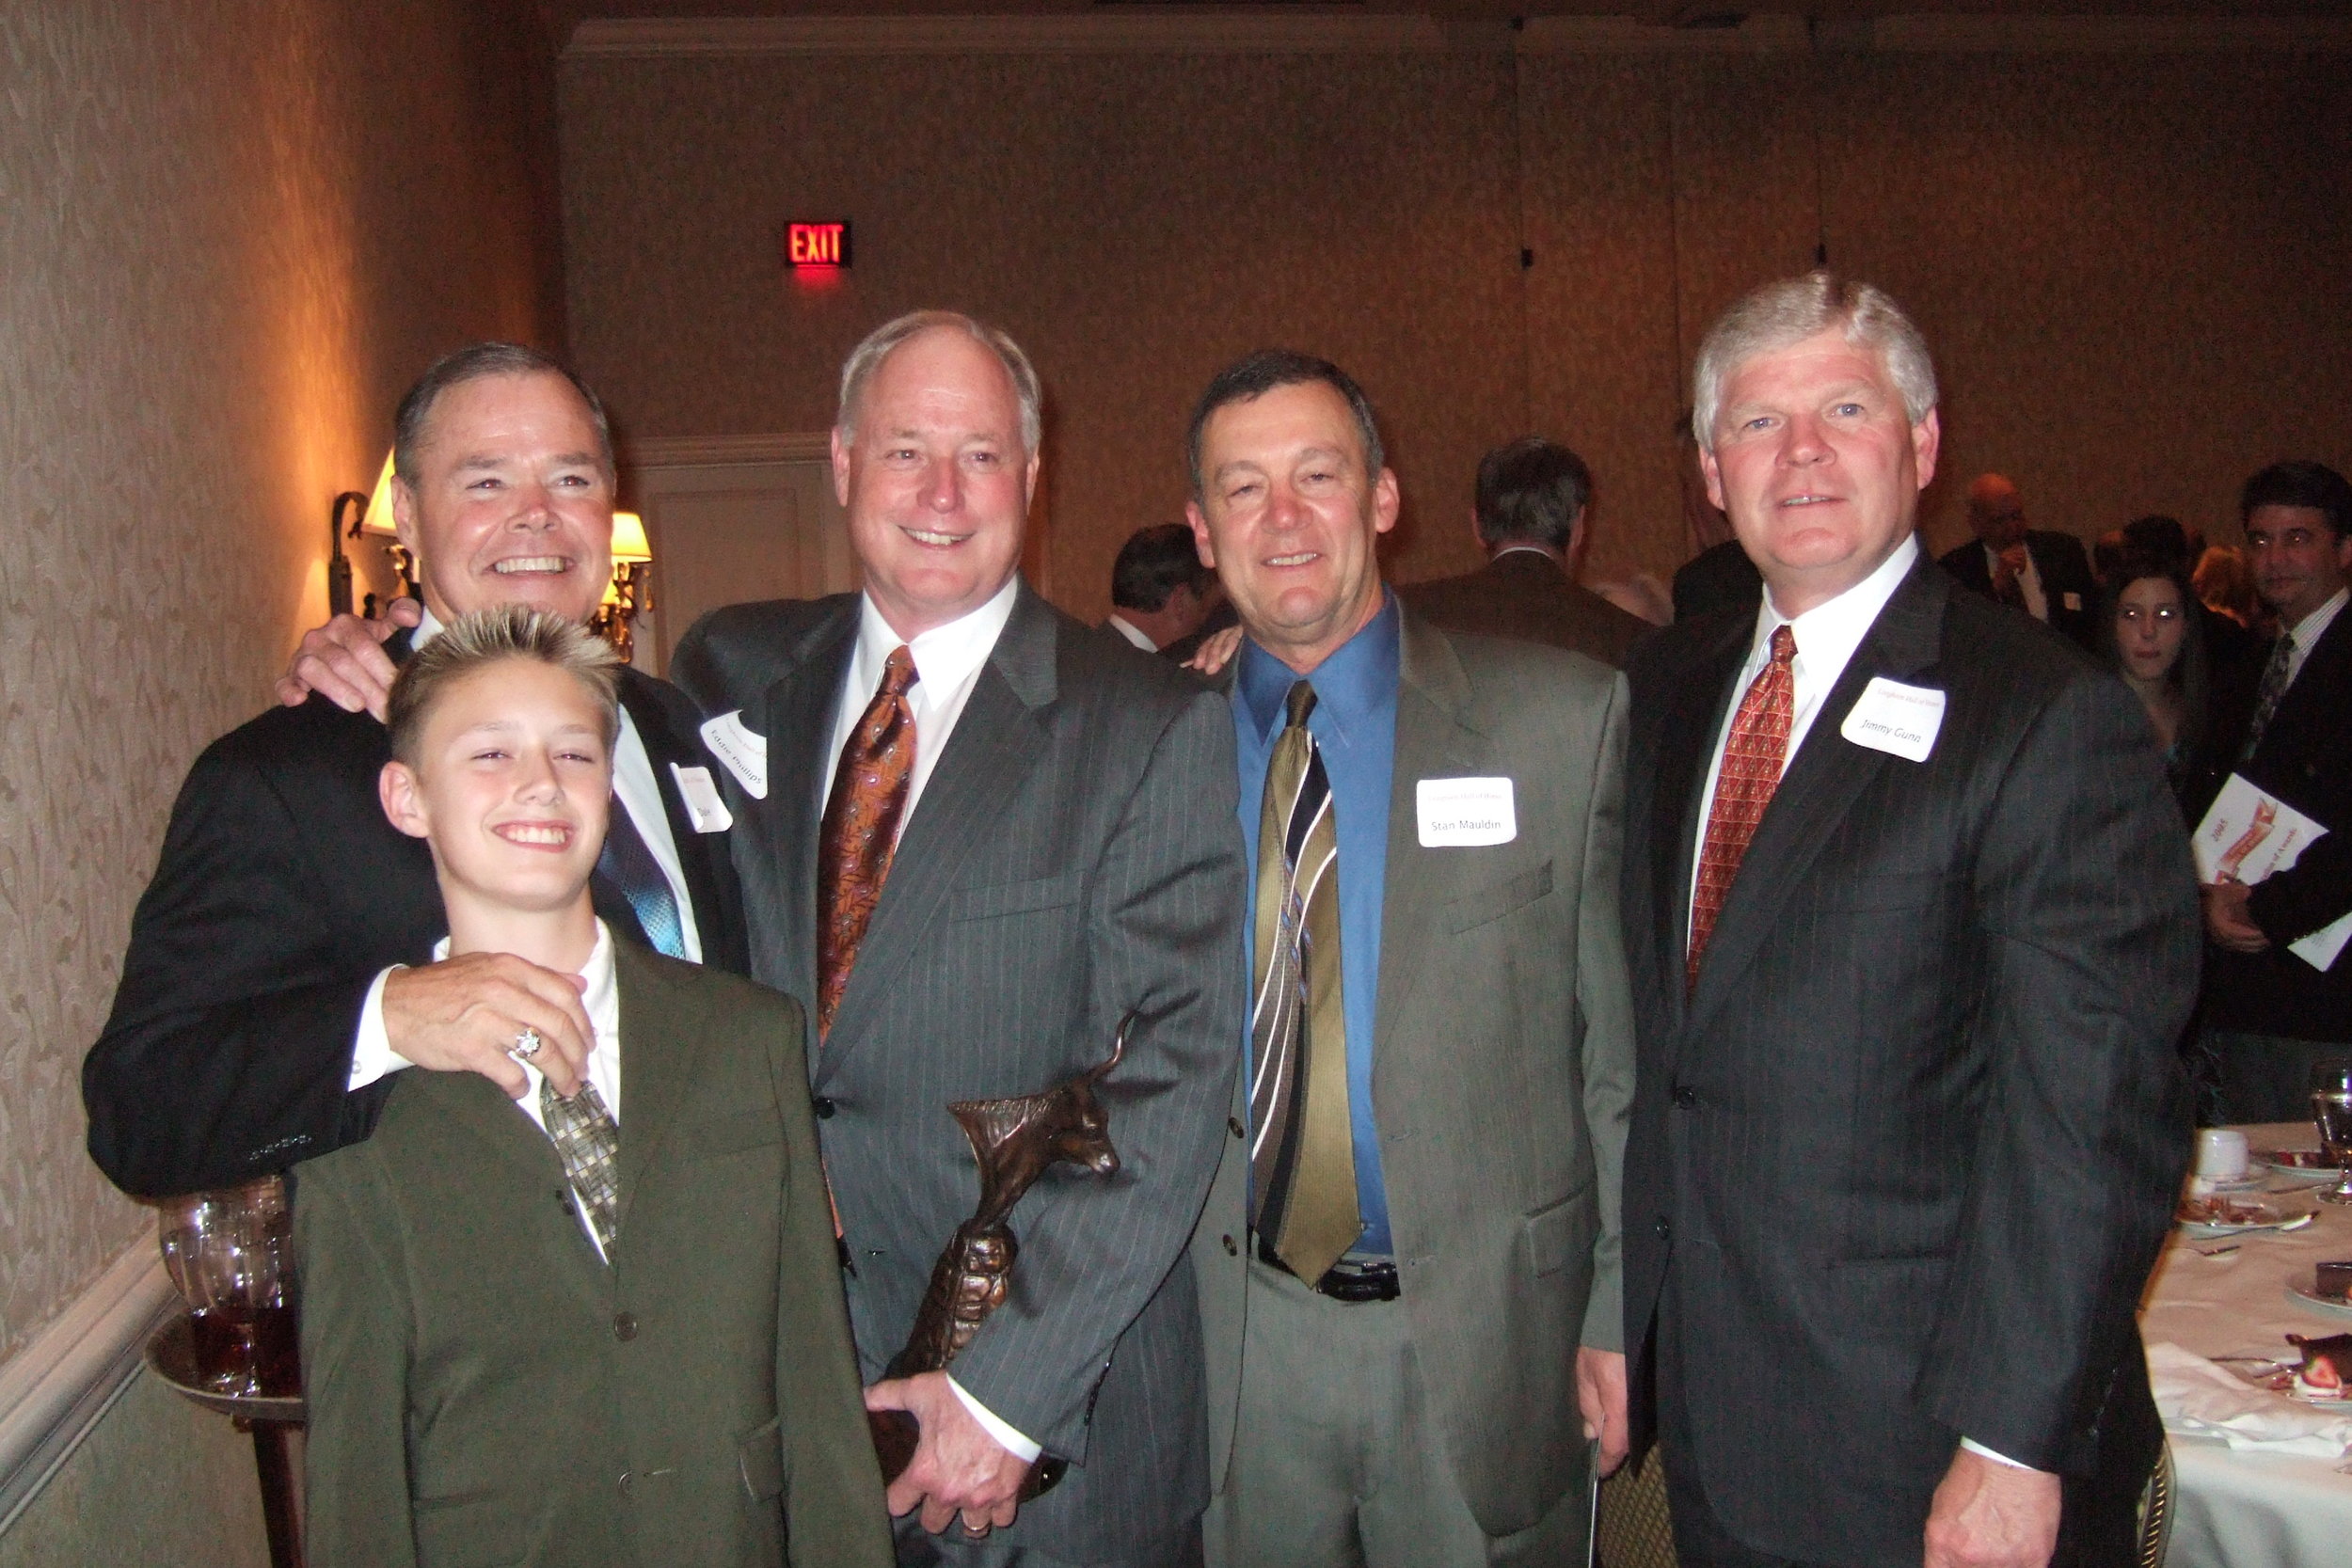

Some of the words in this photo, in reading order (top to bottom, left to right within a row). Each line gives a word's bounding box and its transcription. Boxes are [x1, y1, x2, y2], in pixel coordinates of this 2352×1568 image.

[789, 224, 844, 263] EXIT
[1860, 719, 1893, 736] Jimmy
[1894, 727, 1922, 743] Gunn
[732, 755, 762, 784] Phillips
[1431, 821, 1455, 832] Stan
[1459, 819, 1502, 830] Mauldin
